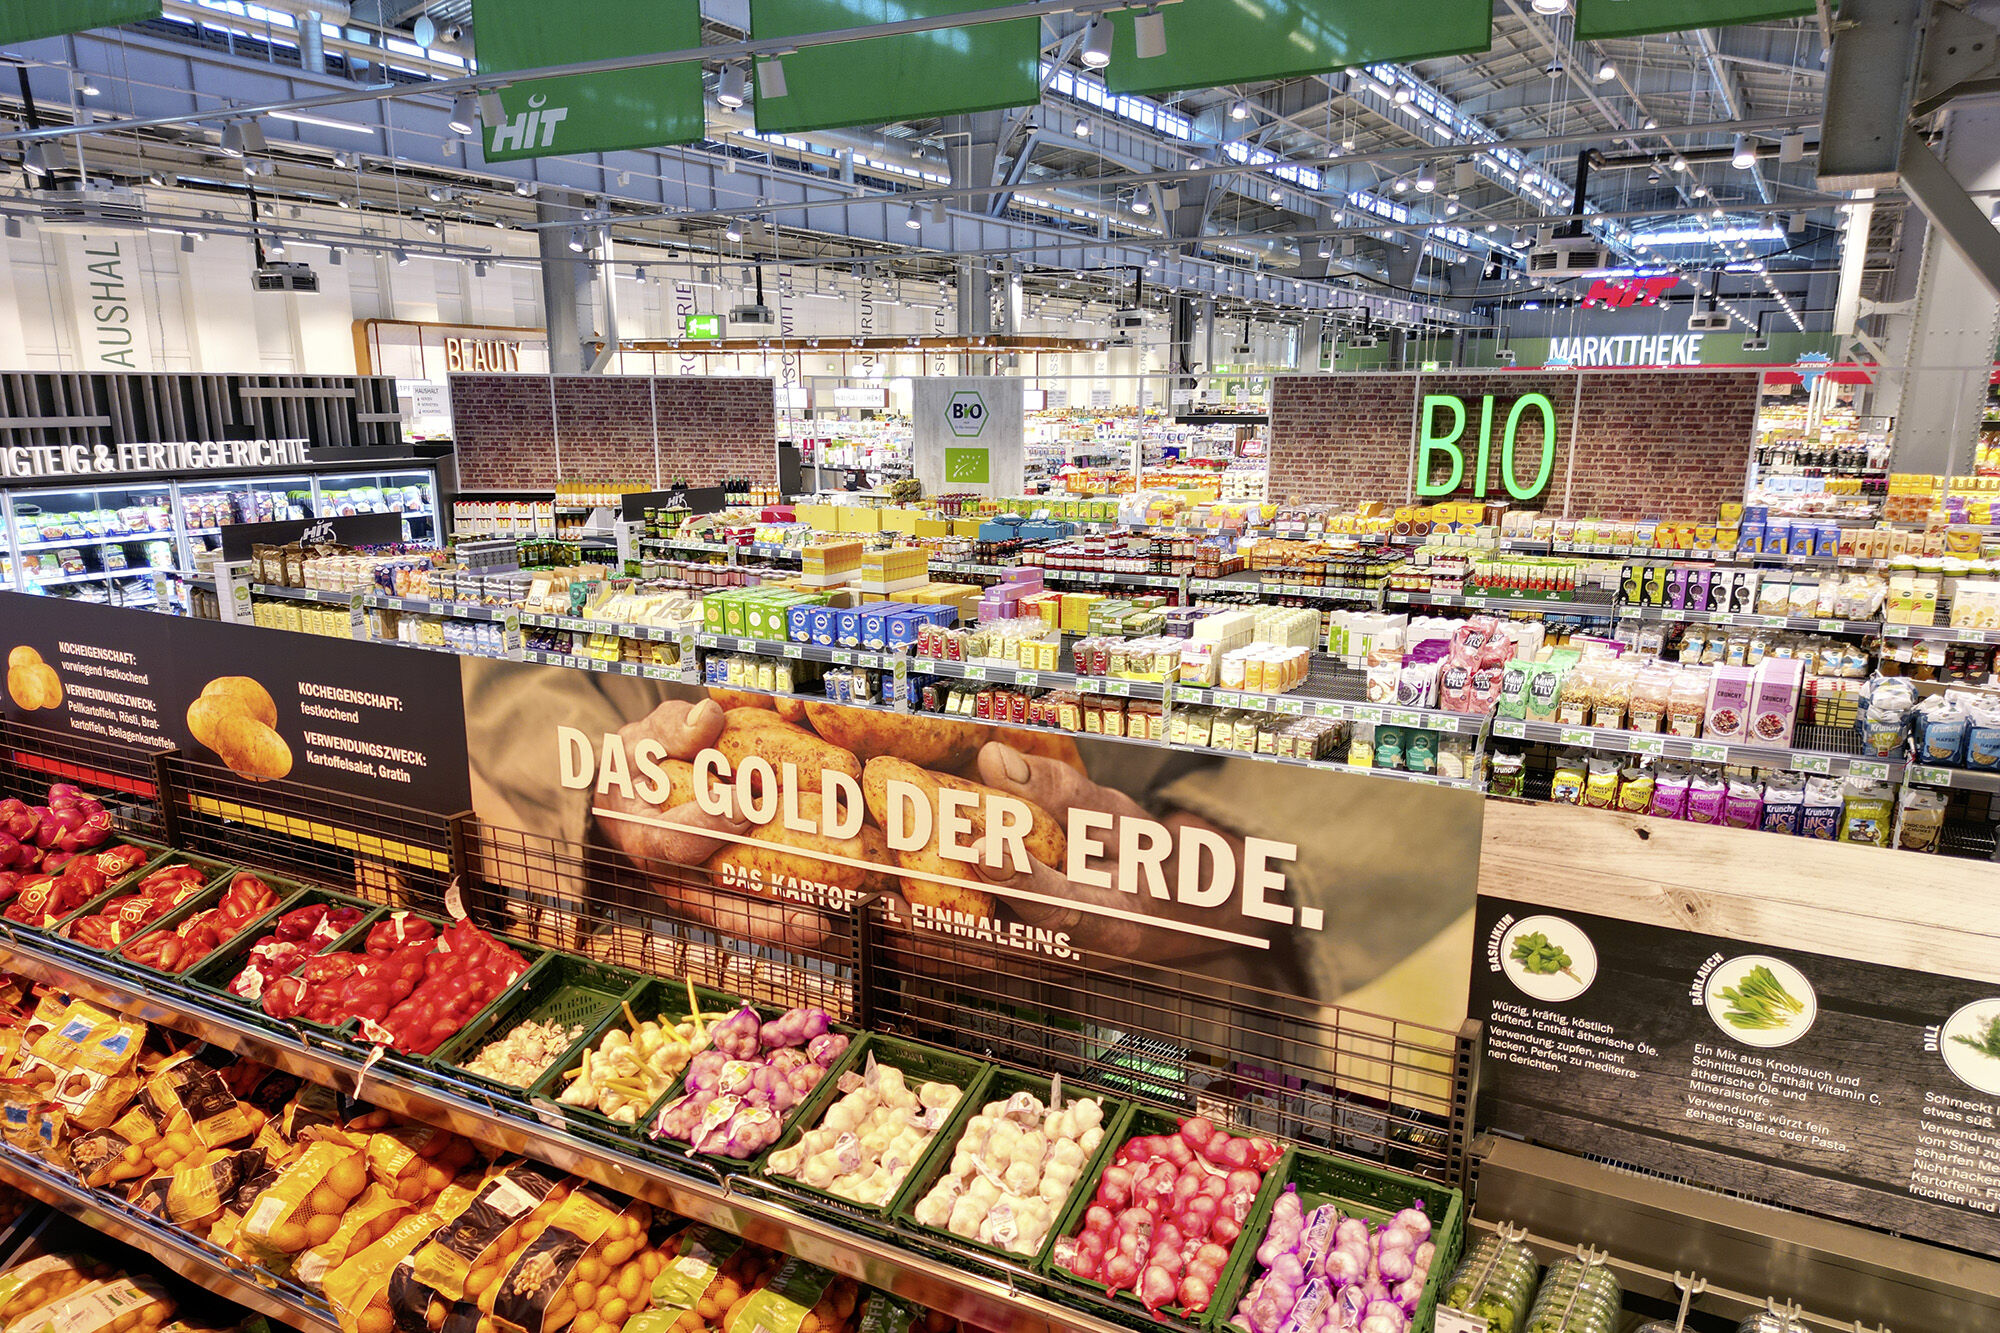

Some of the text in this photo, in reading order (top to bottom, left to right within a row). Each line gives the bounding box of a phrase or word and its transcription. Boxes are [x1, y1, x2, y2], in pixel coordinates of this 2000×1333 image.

[1580, 276, 1681, 309] HIT
[444, 337, 522, 372] BEAUTY
[1550, 335, 1704, 367] MARKTTHEKE
[94, 444, 115, 472] &
[117, 438, 314, 472] FERTIGGERICHTE
[1415, 392, 1557, 501] BIO
[59, 641, 136, 665] KOCHEIGENSCHAFT:
[62, 660, 148, 685] vorwiegend festkochend
[65, 684, 156, 712] VERWENDUNGSZWECK:
[298, 682, 403, 711] KOCHEIGENSCHAFT:
[301, 702, 359, 723] festkochend
[68, 701, 159, 730] Pellkartoffeln, Rösti, Brat-
[70, 718, 175, 750] kartoffeln, Beilagenkartoffeln
[304, 731, 427, 766] VERWENDUNGSZWECK:
[306, 750, 411, 783] Kartoffelsalat, Gratin
[1766, 805, 1797, 814] Krunchy
[1805, 808, 1836, 817] Krunchy
[557, 725, 1325, 931] DAS GOLD DER ERDE.
[721, 862, 764, 892] DAS
[911, 901, 1081, 961] EINMALEINS.
[1487, 913, 1515, 972] BASILIKUM
[1689, 952, 1725, 1006] BÄRLAUCH
[1492, 1000, 1614, 1034] Würzig, kräftig, köstlich
[1490, 1026, 1625, 1064] Verwendung: zupfen, nicht
[1491, 1012, 1659, 1056] duftend. Enthält ätherische Öle.
[1924, 1024, 1941, 1052] DILL
[1488, 1050, 1561, 1073] nen Gerichten.
[1489, 1037, 1640, 1079] hacken. Perfekt zu mediterra-
[1694, 1043, 1860, 1087] Ein Mix aus Knoblauch und
[1689, 1080, 1774, 1107] Mineralstoffe.
[1691, 1069, 1806, 1101] ätherische Öle und
[1692, 1055, 1768, 1081] Schnittlauch.
[1771, 1072, 1814, 1091] Enthält
[1817, 1082, 1865, 1101] Vitamin
[1687, 1094, 1830, 1135] Verwendung: würzt fein
[1923, 1106, 1996, 1129] etwas süß.
[1925, 1091, 1993, 1115] Schmeckt
[1685, 1108, 1850, 1153] gehackt Salate oder Pasta.
[1918, 1134, 1946, 1148] vom
[1949, 1141, 1980, 1156] Stiel
[1913, 1158, 1949, 1174] Nicht
[1915, 1147, 1974, 1168] scharfen
[1909, 1183, 1996, 1213] früchten und
[1911, 1172, 1982, 1197] Kartoffeln,
